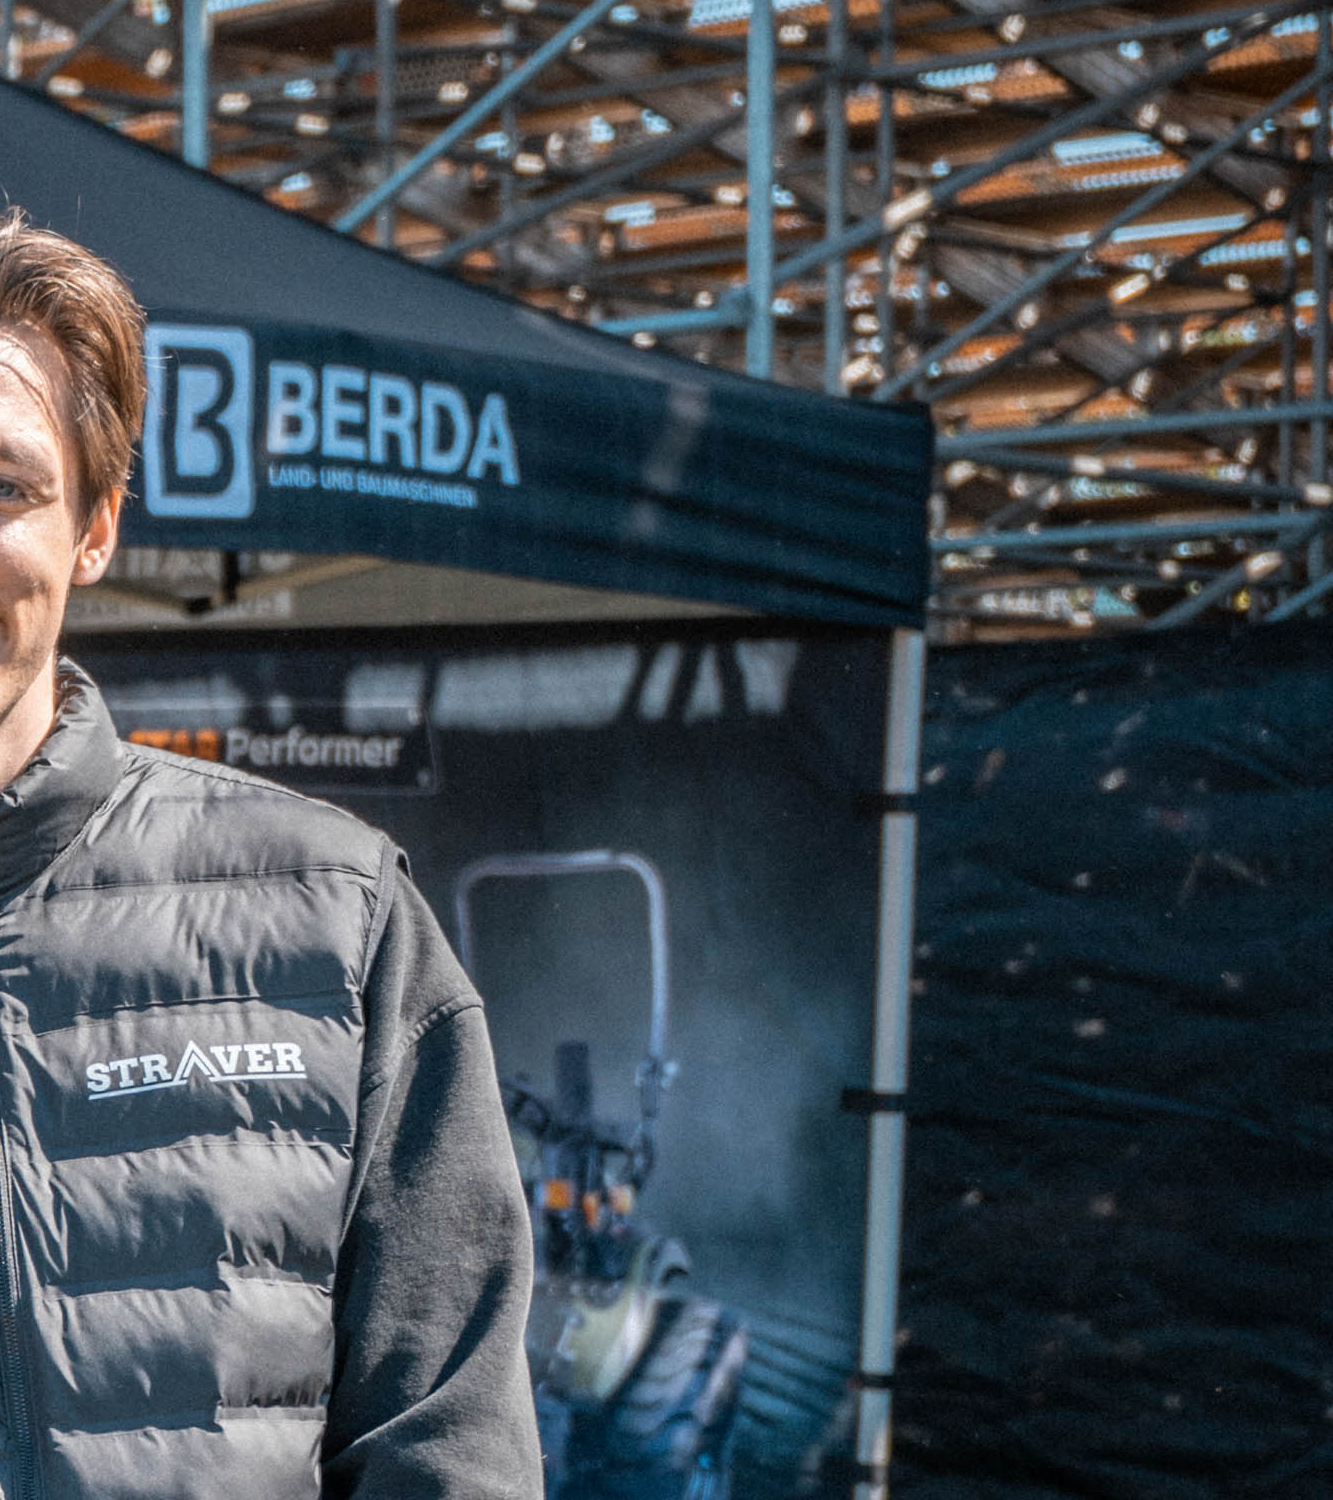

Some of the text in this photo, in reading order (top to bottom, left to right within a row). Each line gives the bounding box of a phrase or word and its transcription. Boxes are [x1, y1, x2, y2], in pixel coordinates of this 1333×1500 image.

[266, 359, 521, 487] BERDA
[226, 725, 402, 768] Performer
[86, 1040, 306, 1098] STRAVER
